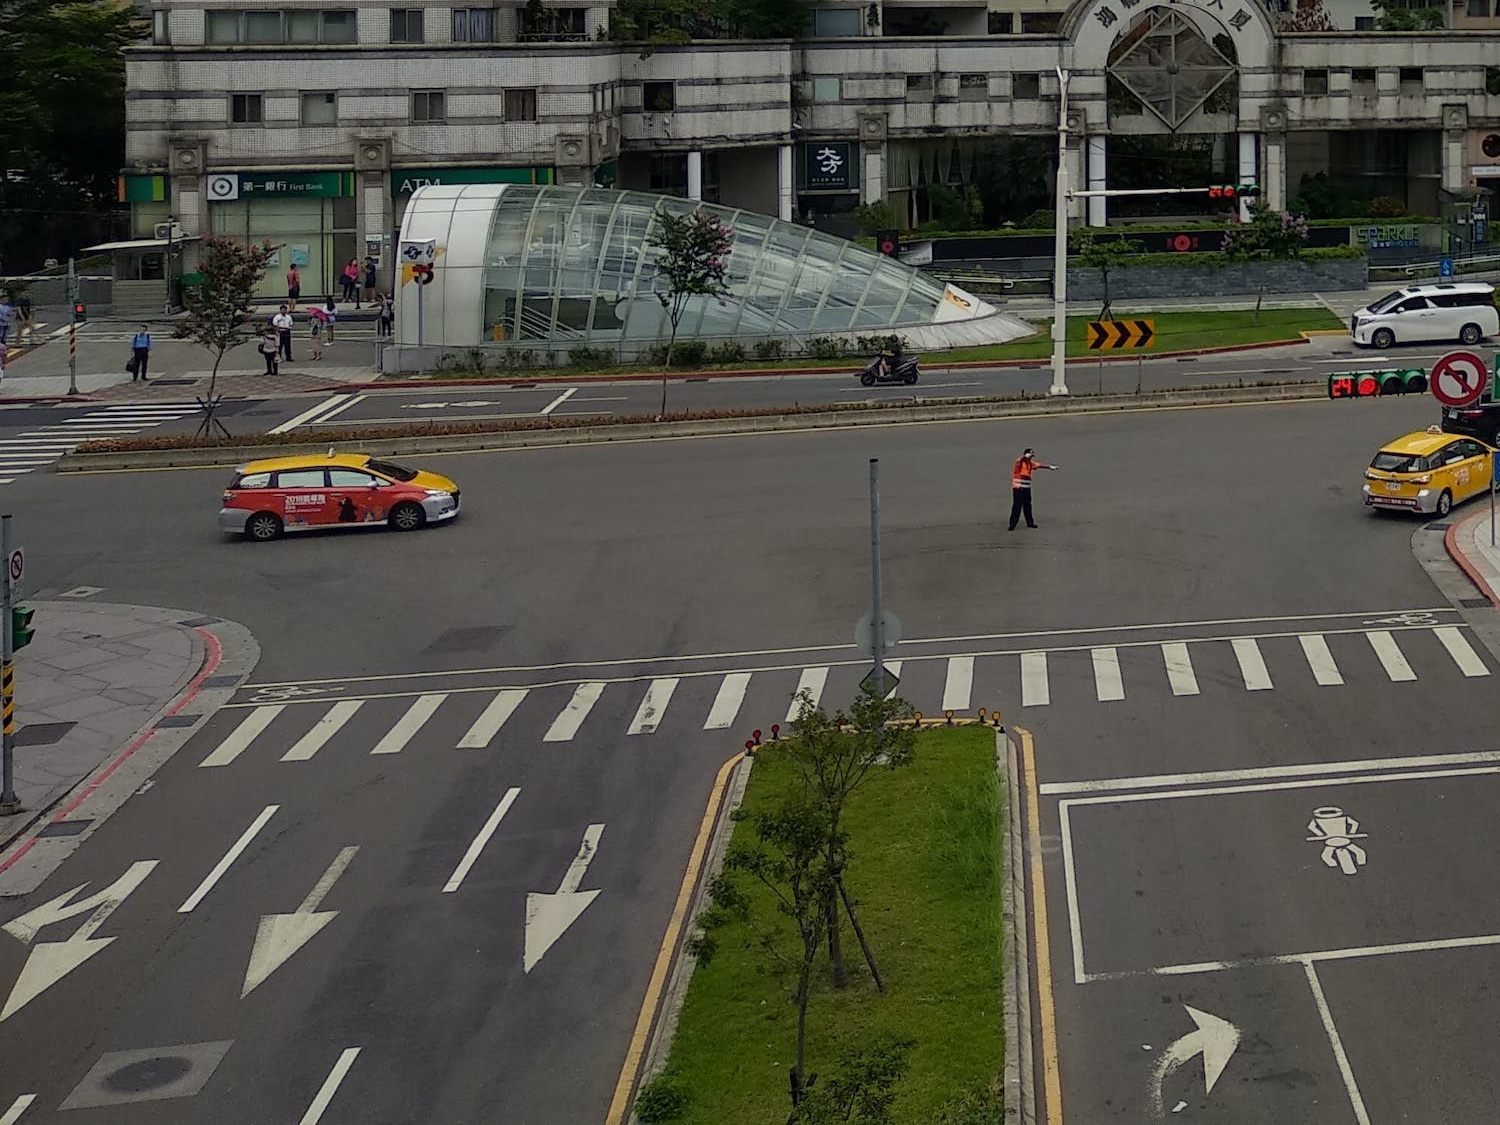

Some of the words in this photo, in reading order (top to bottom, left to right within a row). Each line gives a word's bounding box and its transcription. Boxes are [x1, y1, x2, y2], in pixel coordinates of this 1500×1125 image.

[243, 181, 287, 192] 第一銀行
[305, 182, 323, 191] Bank
[1333, 378, 1351, 396] 24
